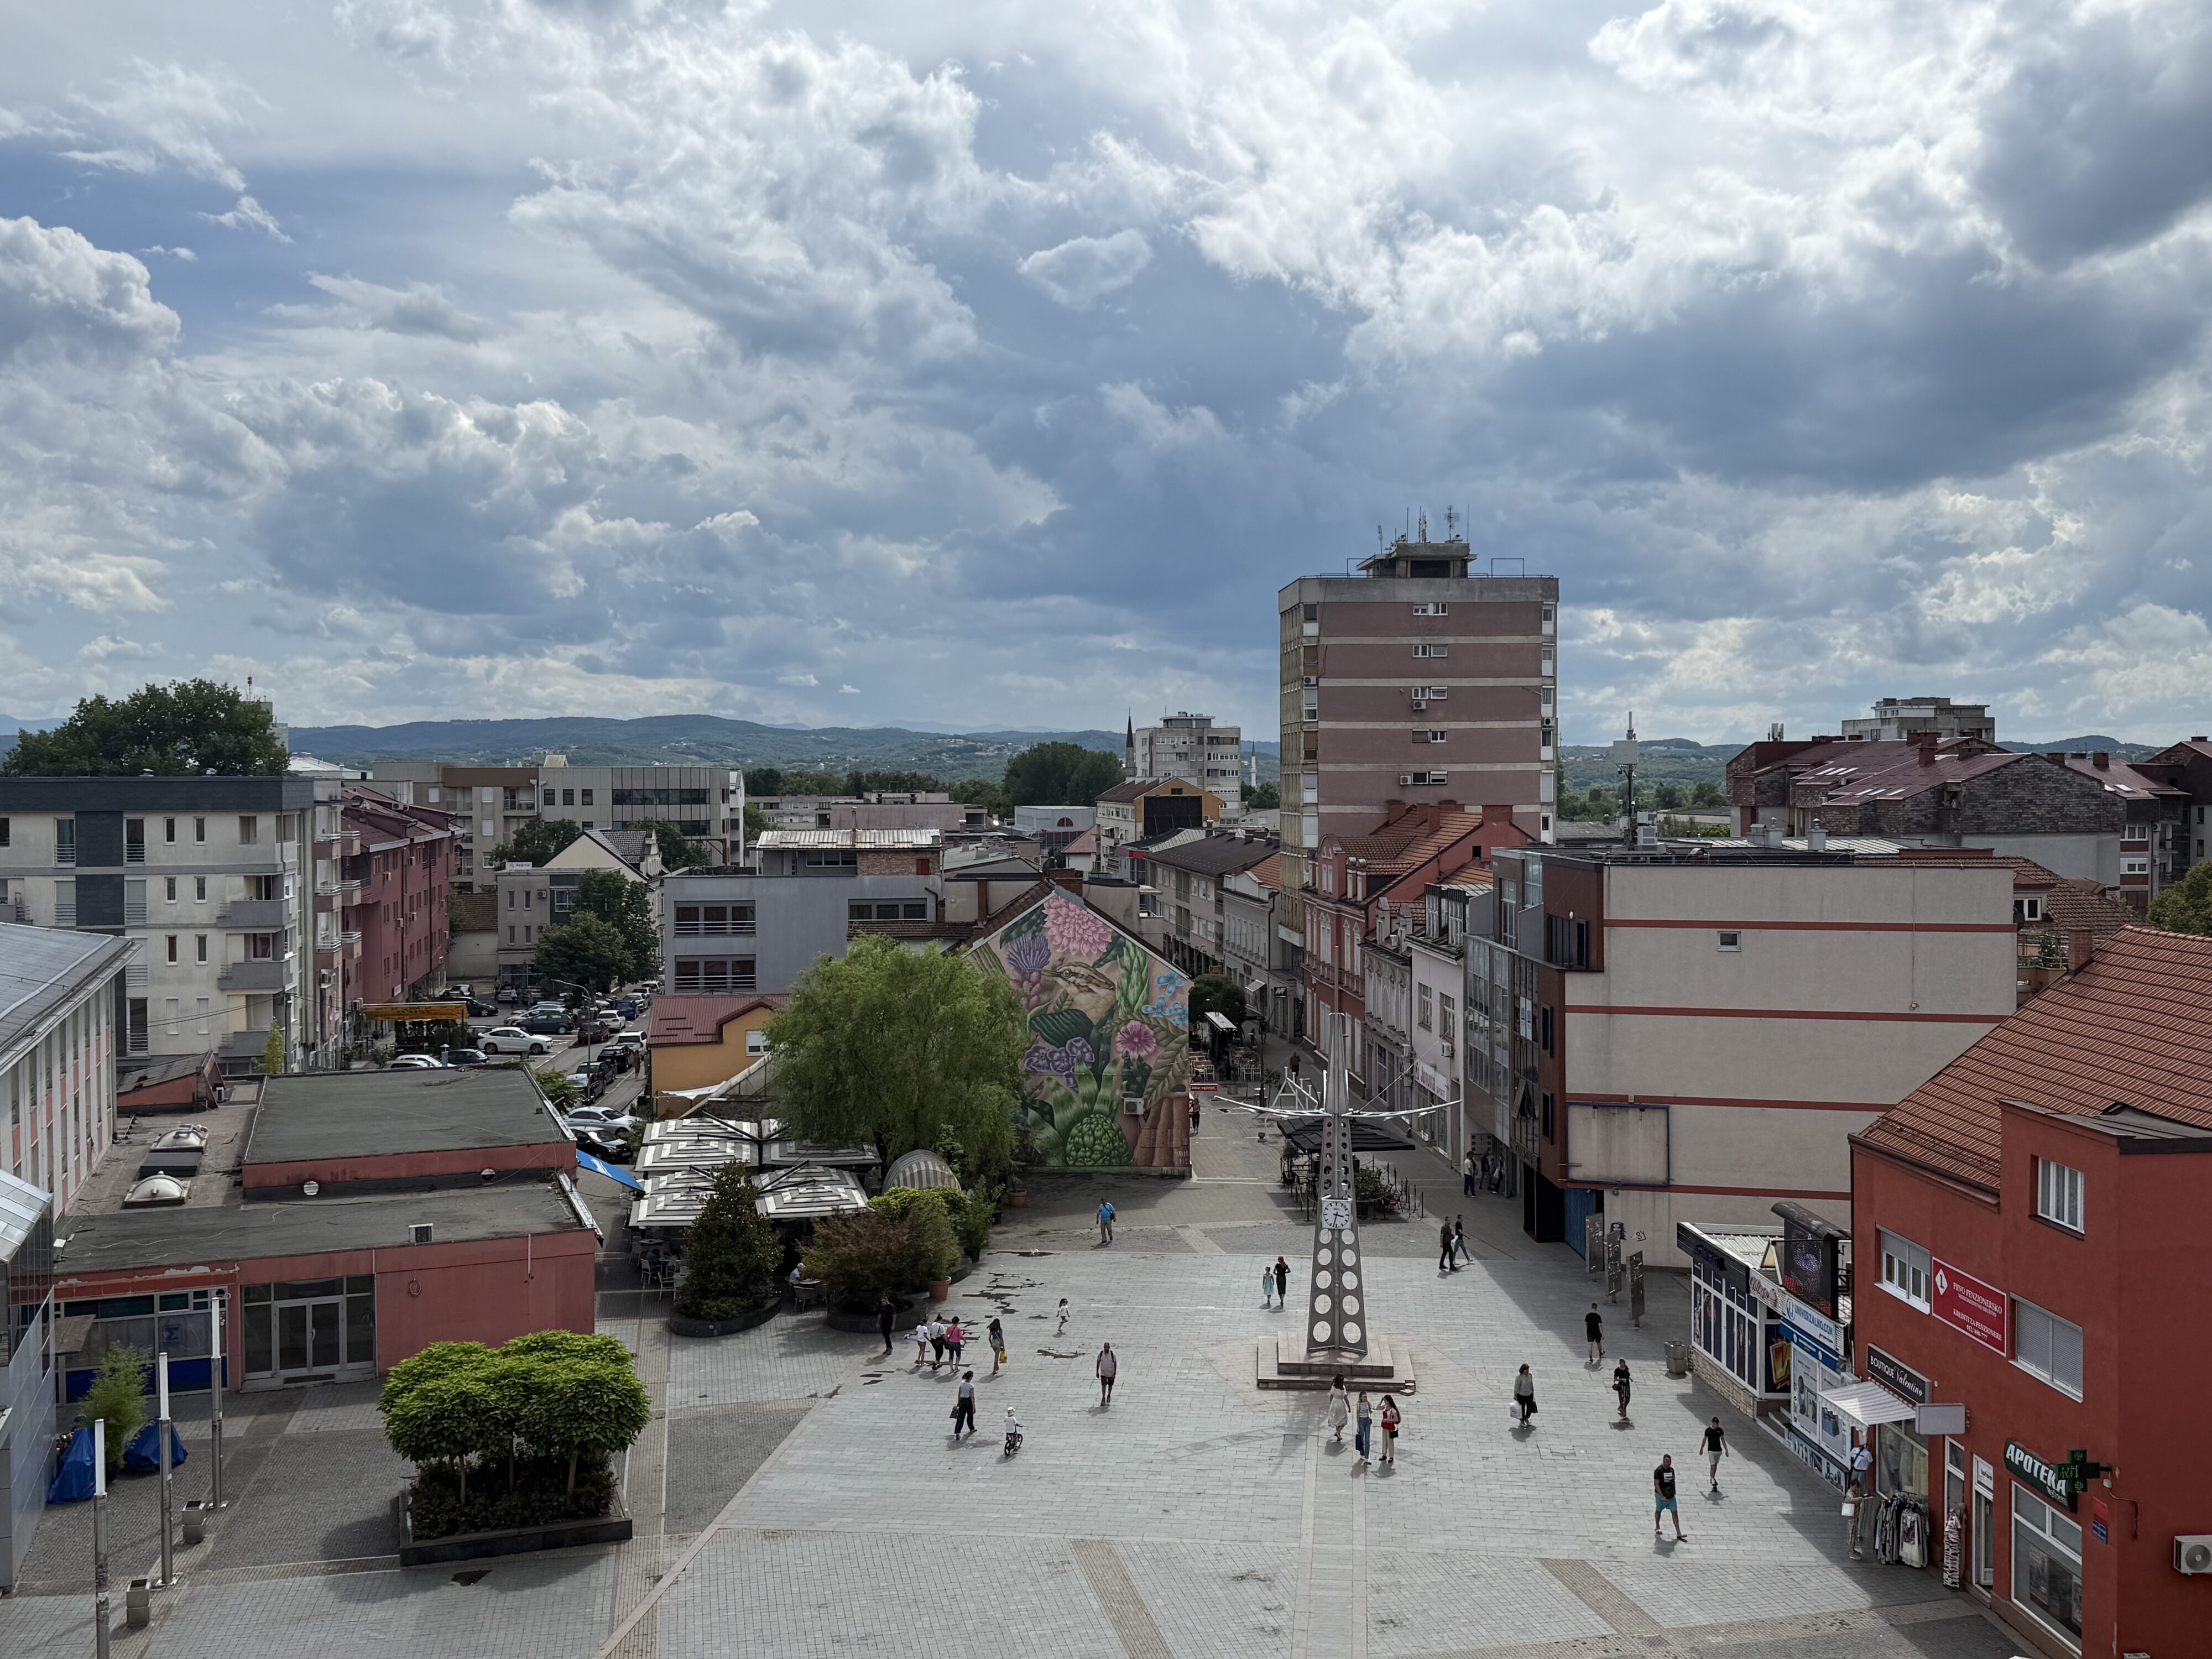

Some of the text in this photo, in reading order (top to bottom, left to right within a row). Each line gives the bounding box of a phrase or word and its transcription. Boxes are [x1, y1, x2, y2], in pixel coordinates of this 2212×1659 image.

[1953, 1282, 2002, 1314] PRVO PENZIONERSKO
[1870, 1355, 1923, 1397] BOUTIQUE Valentino
[2005, 1443, 2066, 1496] APOTEKA
